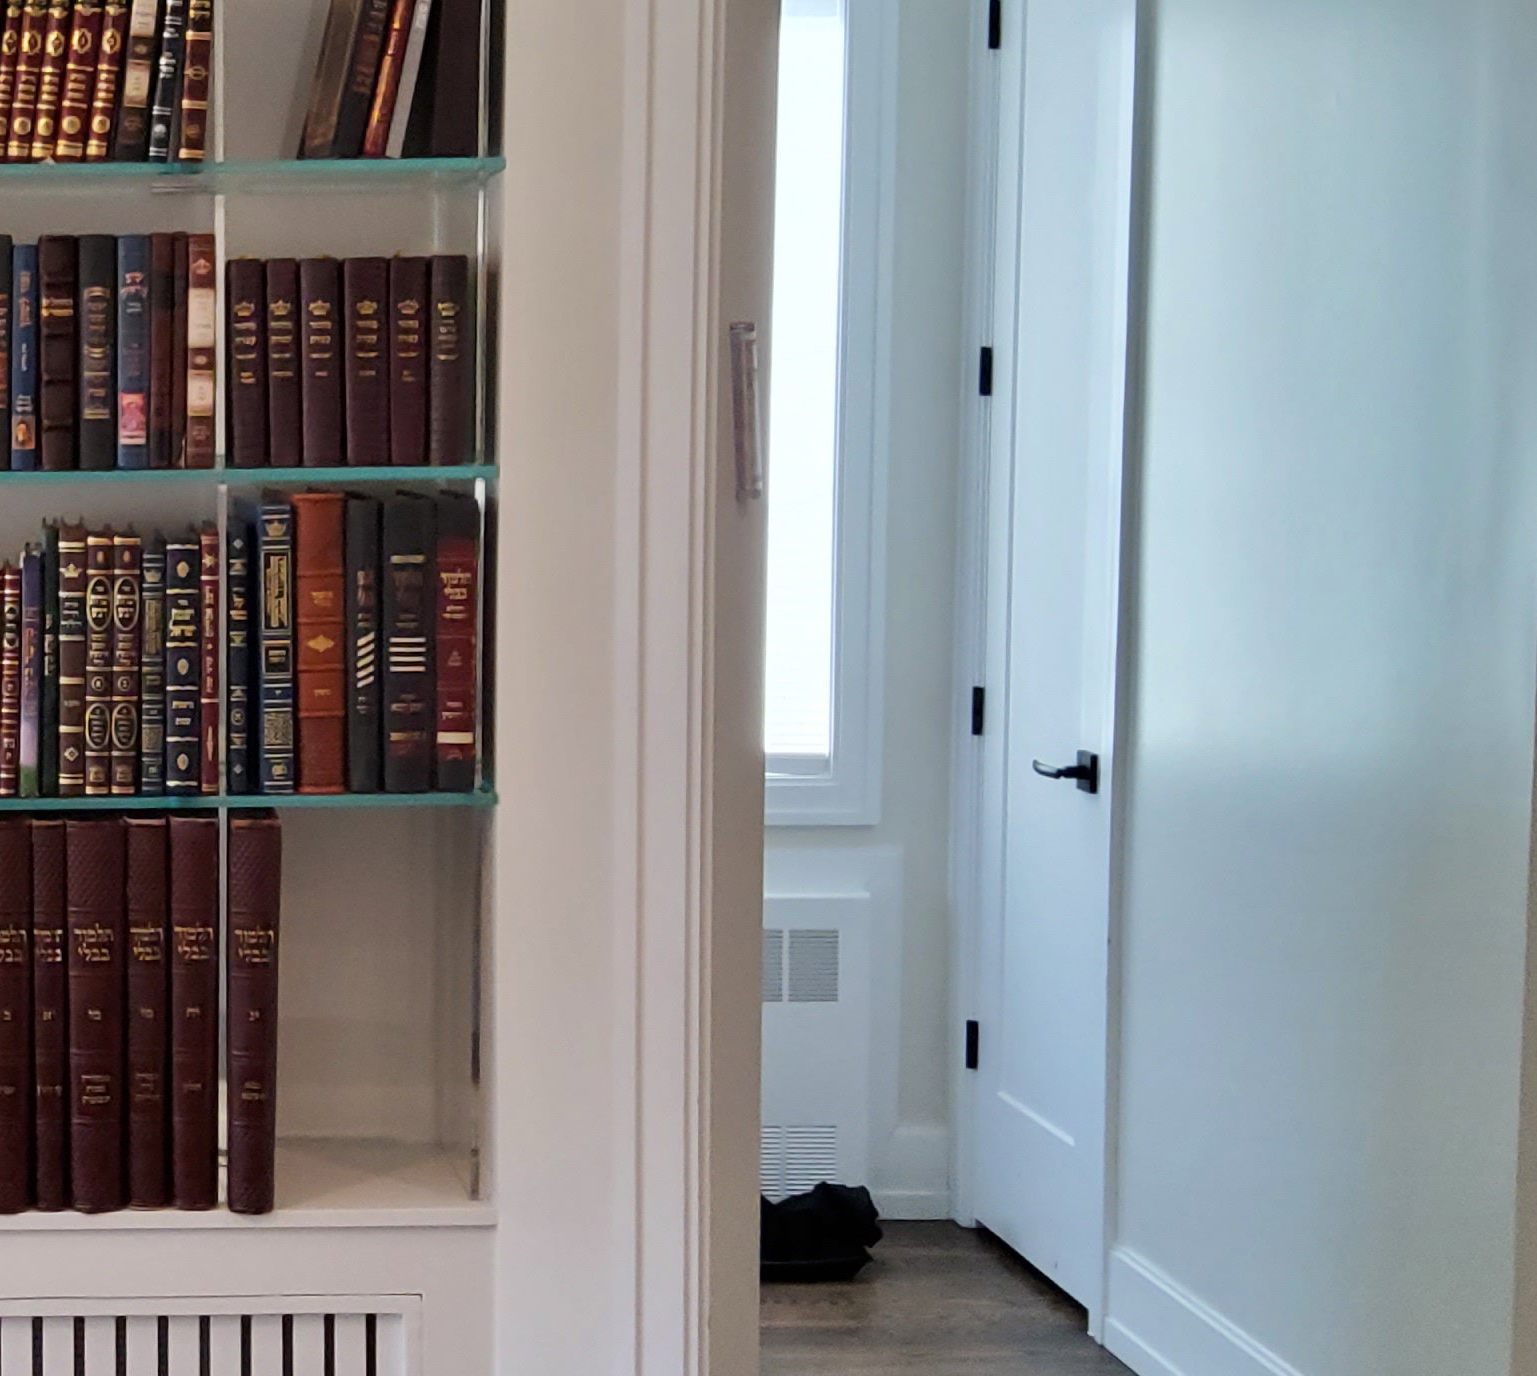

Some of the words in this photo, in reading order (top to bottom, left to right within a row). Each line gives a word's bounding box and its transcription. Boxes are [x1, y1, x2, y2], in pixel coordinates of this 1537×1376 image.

[72, 922, 113, 942] תלמוד
[173, 921, 213, 942] תלמוד
[234, 924, 274, 943] תלמוד
[78, 942, 110, 961] בבלי
[133, 941, 161, 960] בבלי
[177, 941, 210, 960] בבלי
